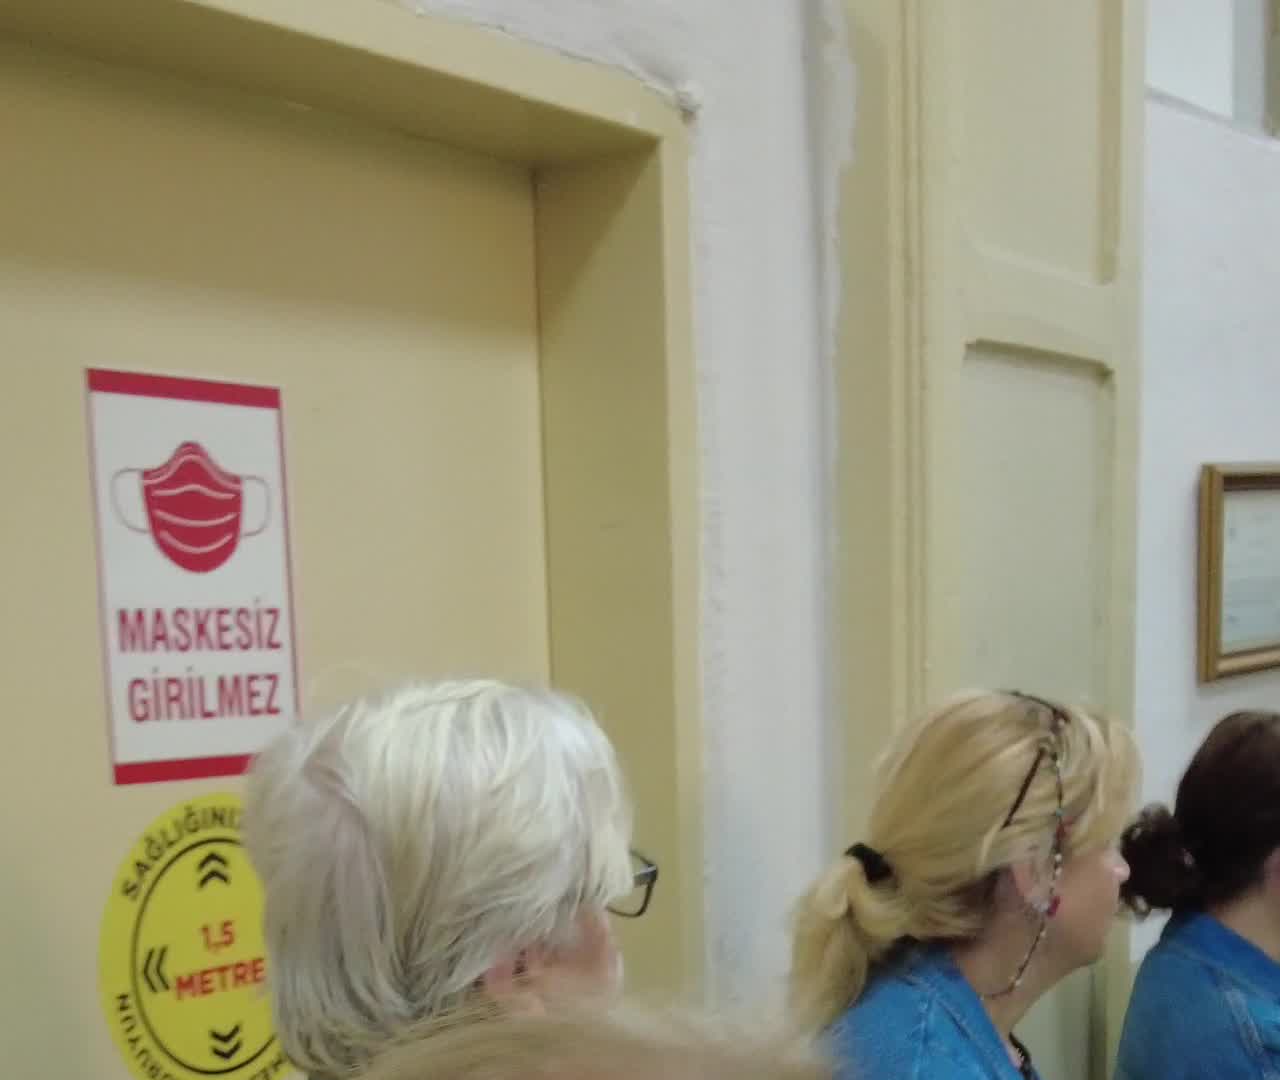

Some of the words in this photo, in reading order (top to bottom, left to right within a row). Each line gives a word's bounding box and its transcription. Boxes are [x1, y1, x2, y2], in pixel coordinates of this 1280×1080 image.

[117, 598, 282, 653] MASKESİZ
[127, 667, 281, 723] GİRİLMEZ
[175, 957, 265, 1000] METRE
